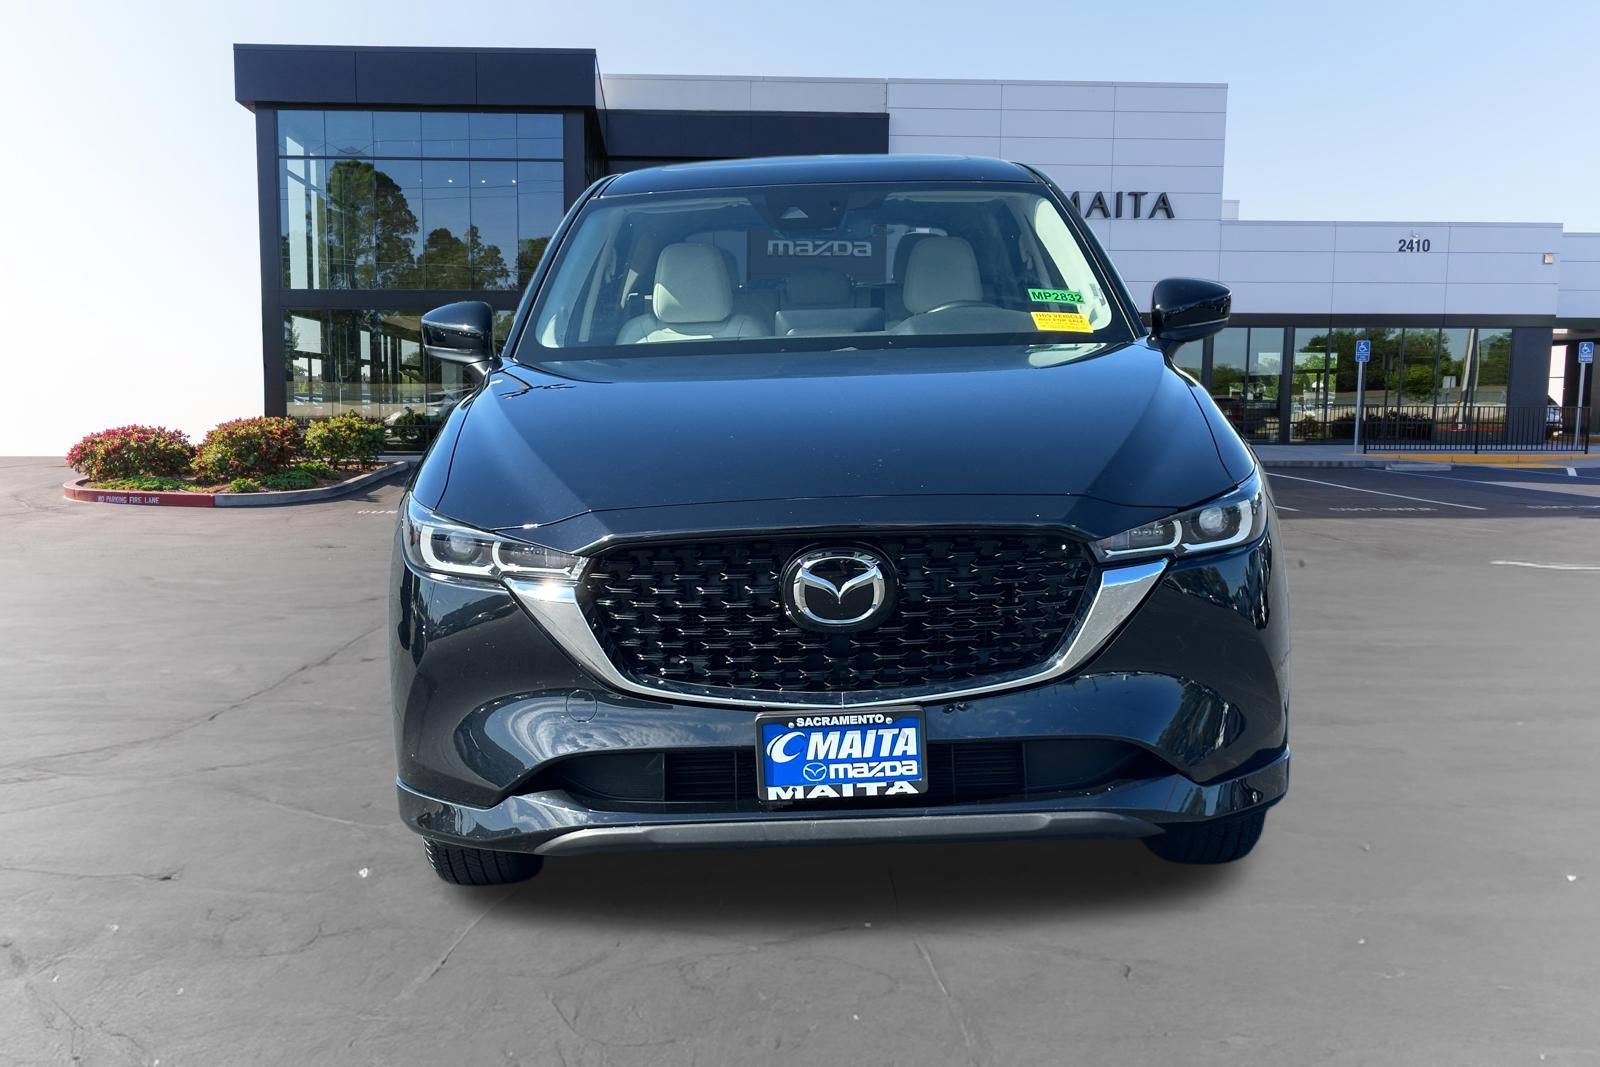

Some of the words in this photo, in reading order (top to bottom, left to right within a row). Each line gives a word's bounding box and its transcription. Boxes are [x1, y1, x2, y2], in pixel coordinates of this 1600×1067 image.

[767, 239, 872, 257] mazda
[1398, 239, 1431, 253] 2410
[1031, 291, 1084, 303] MP2832
[129, 496, 142, 504] FIRE
[144, 496, 160, 505] LANE
[796, 714, 885, 727] SACRAMENTO
[806, 727, 918, 761] MAITA
[829, 760, 919, 779] mazda
[767, 780, 919, 800] MAITA
